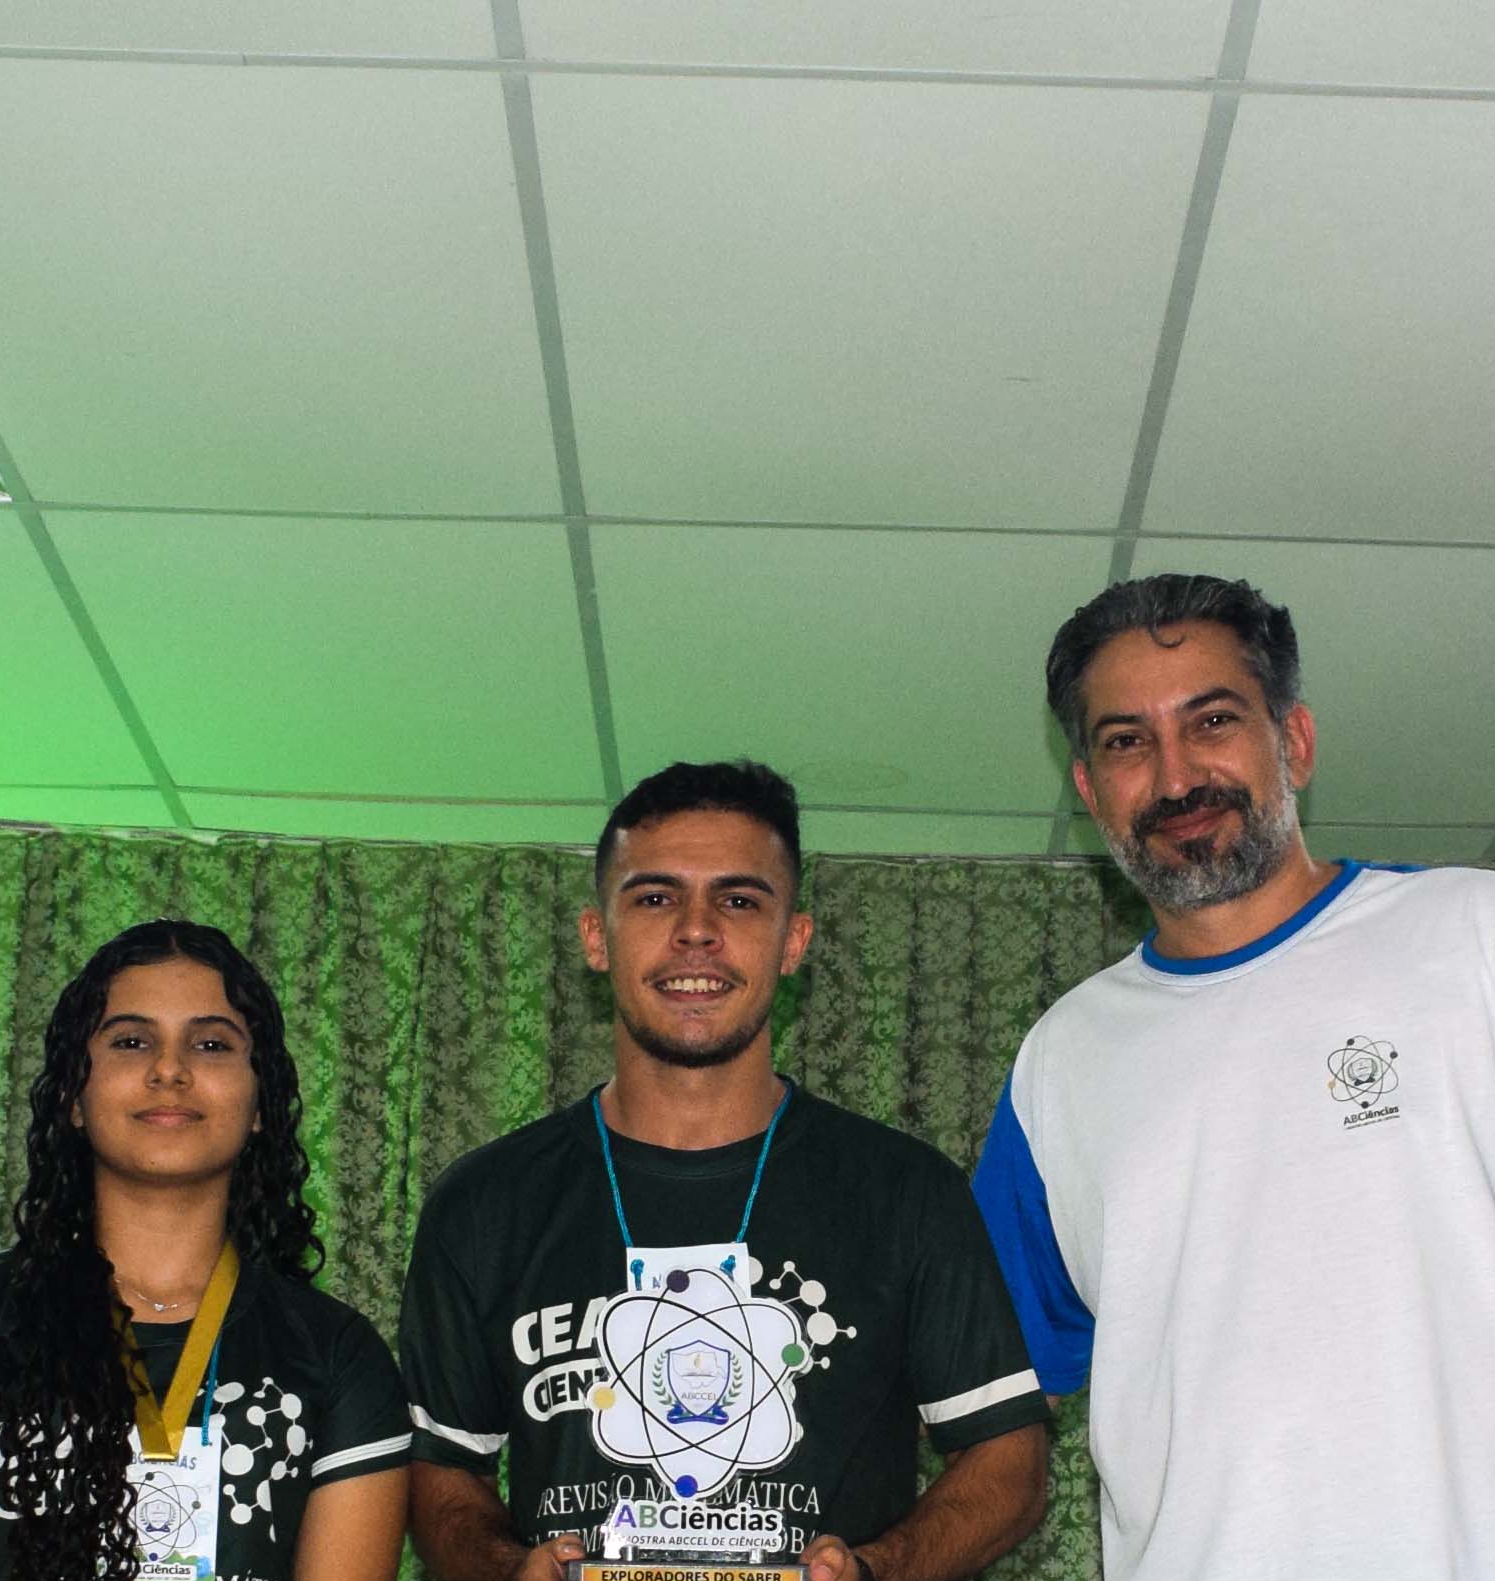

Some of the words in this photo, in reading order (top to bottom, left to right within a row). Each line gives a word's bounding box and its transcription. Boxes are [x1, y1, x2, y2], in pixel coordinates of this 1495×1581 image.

[614, 1503, 779, 1532] ABCiências
[668, 1536, 709, 1546] ABCCEL
[711, 1537, 726, 1546] DE
[728, 1535, 778, 1547] CIÊNCIAS
[142, 1563, 191, 1575] Ciências
